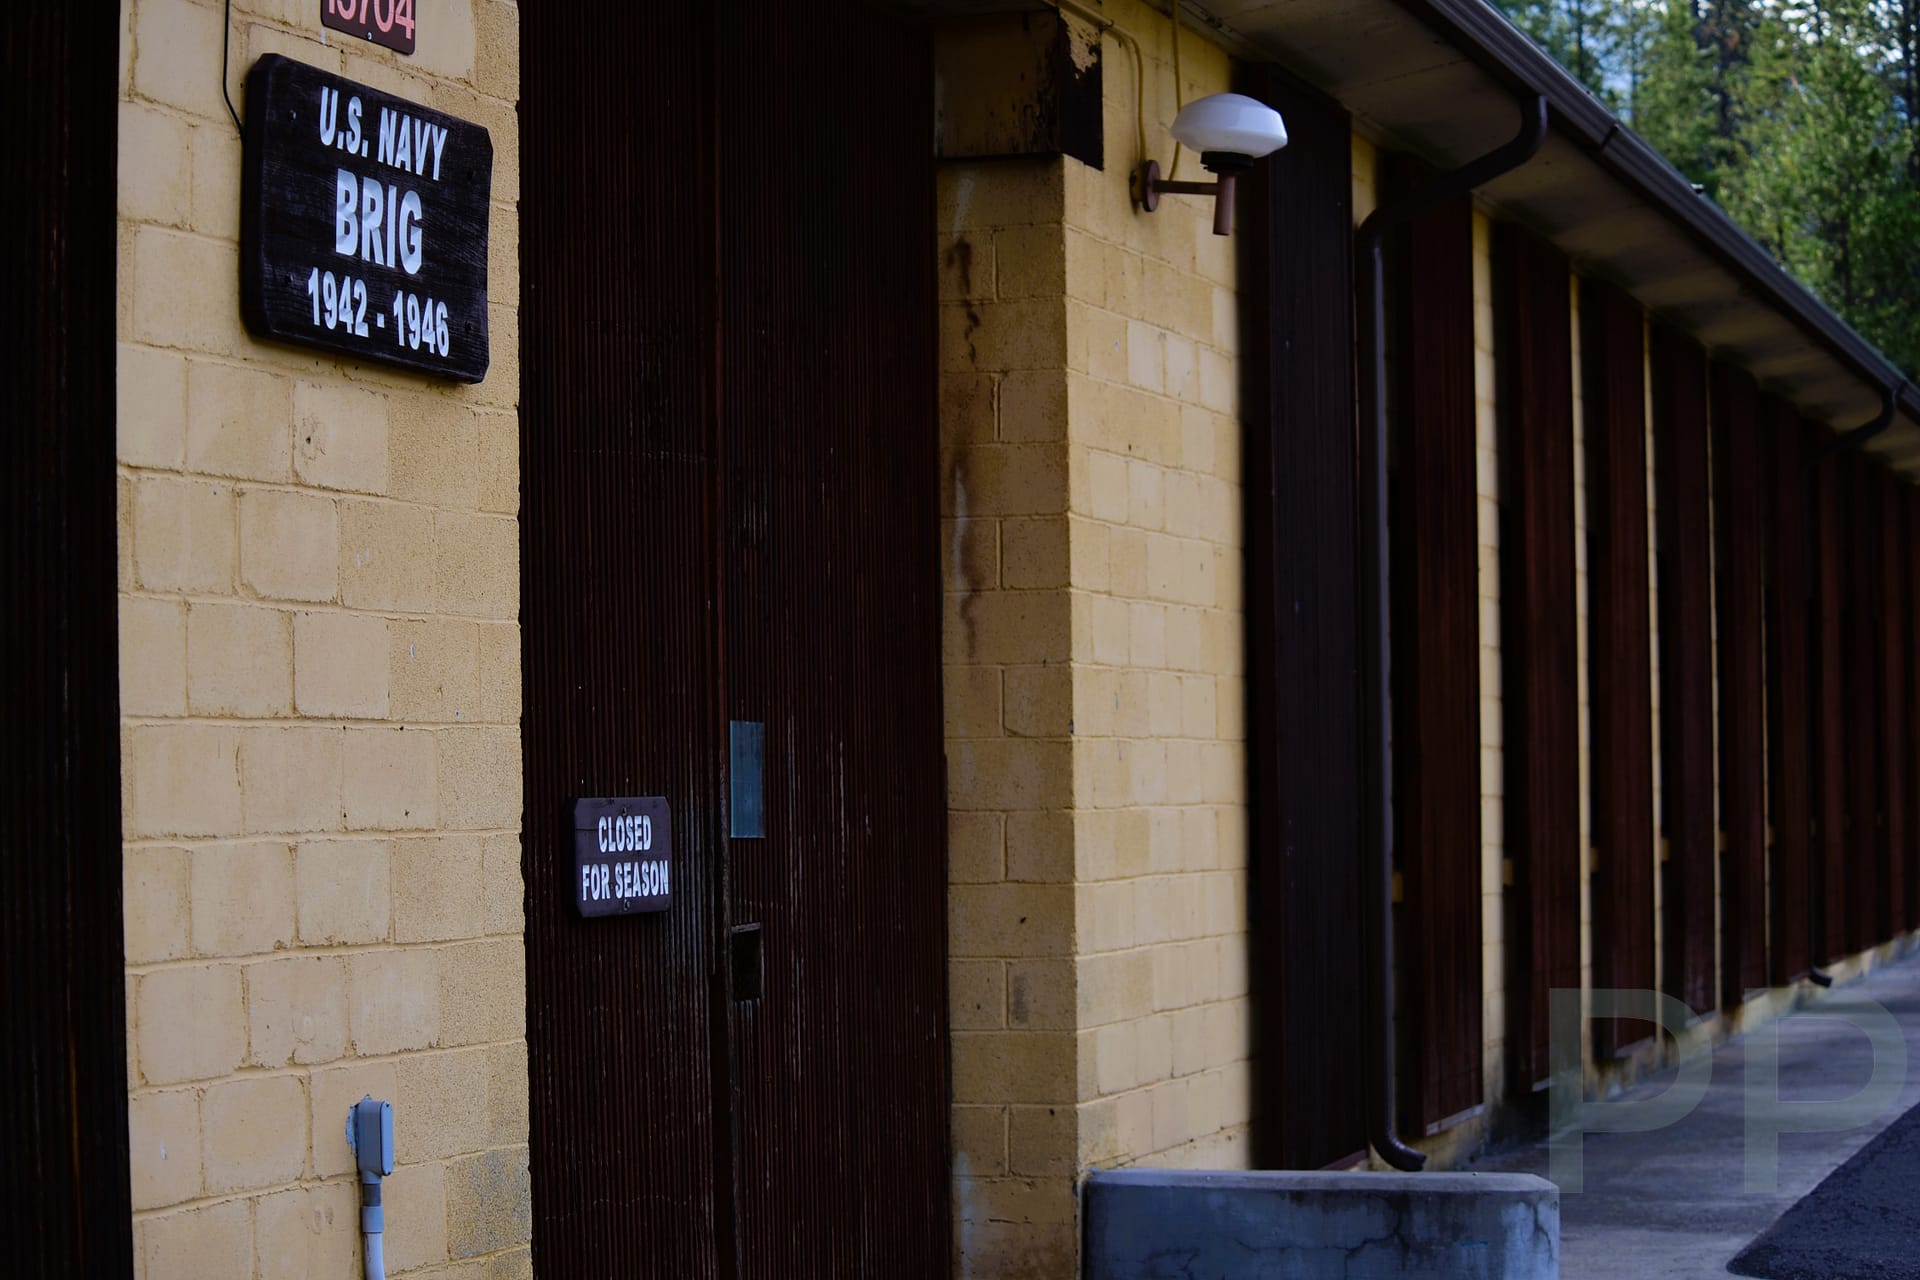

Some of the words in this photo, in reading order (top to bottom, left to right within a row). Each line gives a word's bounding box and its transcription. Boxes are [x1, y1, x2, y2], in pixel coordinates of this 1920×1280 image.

[319, 85, 368, 157] U.S.
[377, 107, 448, 181] NAVY
[335, 168, 423, 275] BRIG
[308, 267, 369, 338] 1942
[377, 313, 385, 328] -
[393, 290, 450, 357] 1946
[598, 815, 652, 853] CLOSED
[582, 863, 611, 901] FOR
[614, 860, 669, 899] SEASON
